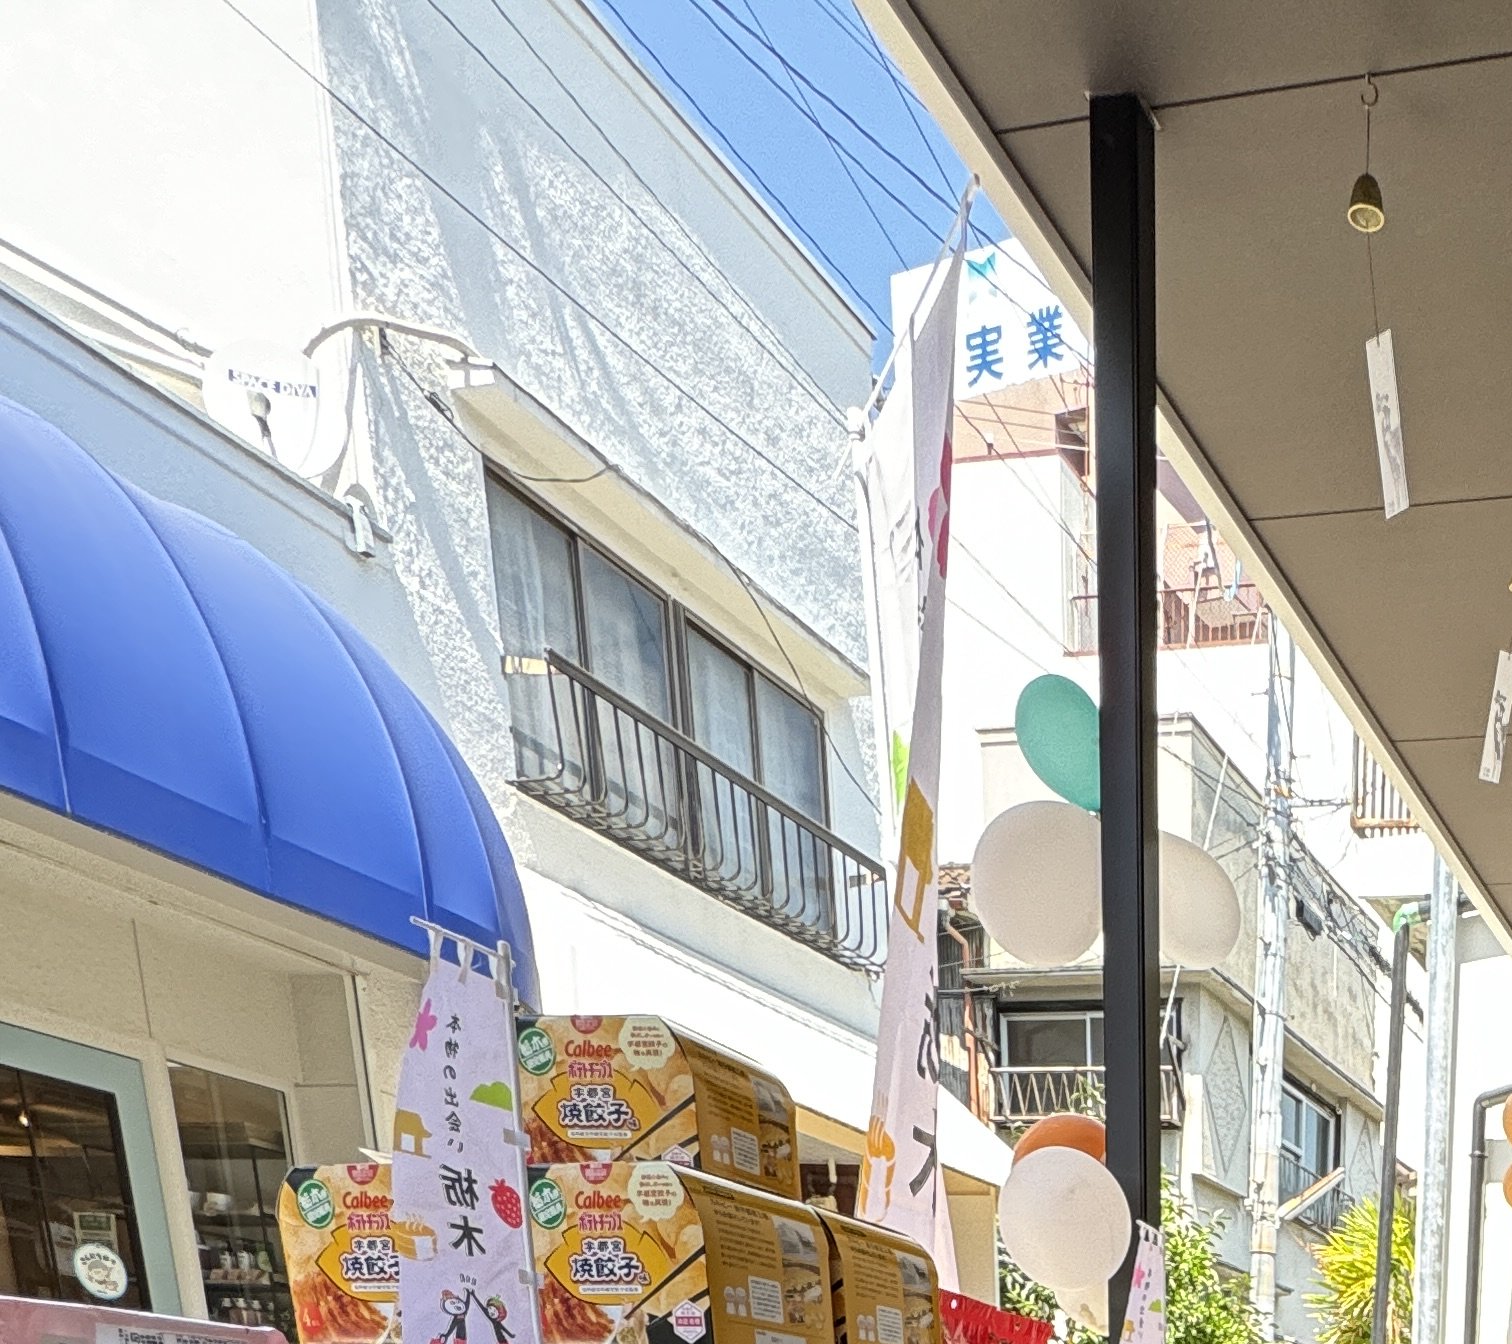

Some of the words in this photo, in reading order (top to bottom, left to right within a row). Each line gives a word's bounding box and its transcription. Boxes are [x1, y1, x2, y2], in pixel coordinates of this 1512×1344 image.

[965, 305, 1065, 388] 実業
[565, 1040, 612, 1058] Calbee
[573, 1087, 611, 1100] 宇都宮
[343, 1192, 389, 1210] Calbee
[575, 1191, 621, 1209] Calbee
[579, 1213, 623, 1232] ポテトチップス
[353, 1239, 391, 1252] 宇都宮
[583, 1240, 623, 1253] 宇都宮
